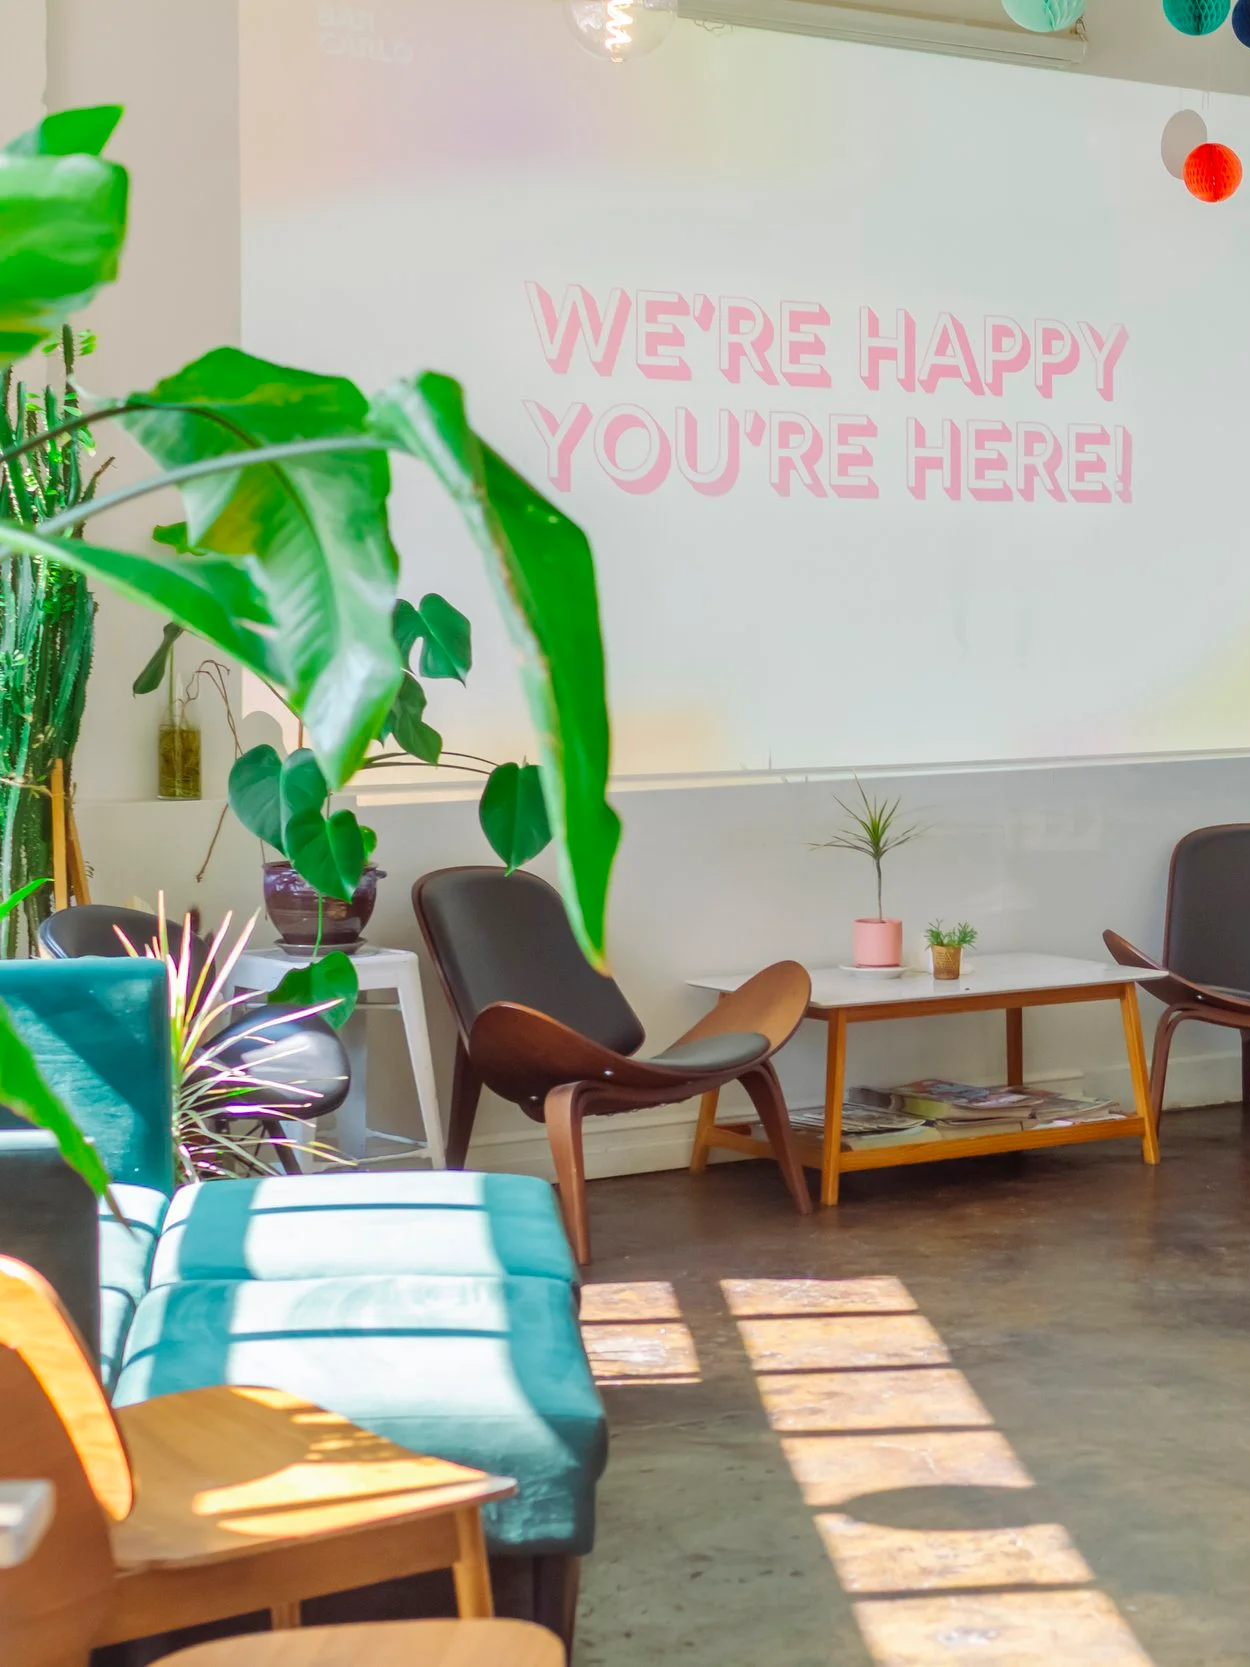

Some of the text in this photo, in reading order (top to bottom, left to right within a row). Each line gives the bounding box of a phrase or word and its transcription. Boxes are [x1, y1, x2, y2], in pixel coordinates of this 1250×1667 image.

[524, 281, 1129, 401] WE'RE HAPPY
[522, 400, 1133, 504] YOU'RE HERE!
